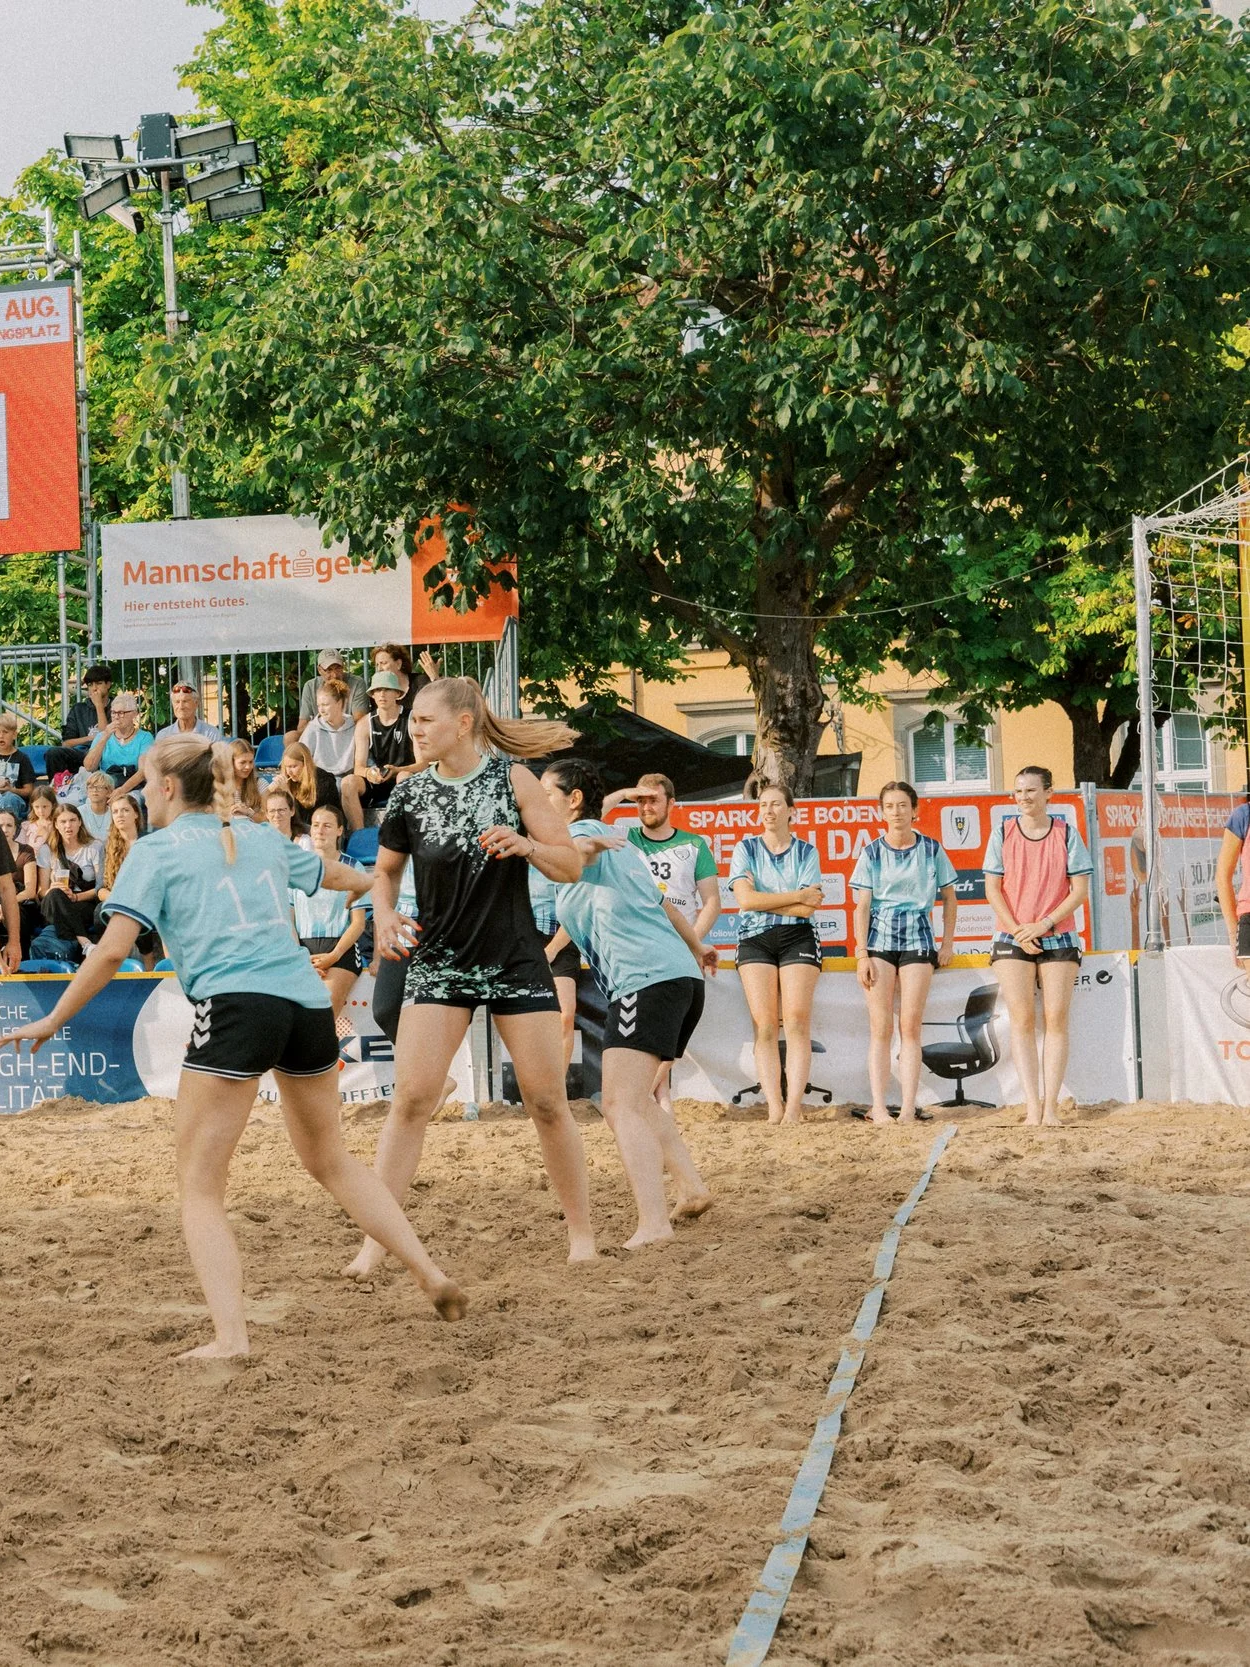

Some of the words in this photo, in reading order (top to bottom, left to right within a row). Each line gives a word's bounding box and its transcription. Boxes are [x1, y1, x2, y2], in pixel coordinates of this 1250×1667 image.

[6, 296, 59, 321] AUG.
[124, 600, 150, 611] Hier
[153, 597, 206, 610] entsteht
[209, 596, 249, 607] Gutes.
[815, 805, 882, 825] BODEN
[650, 861, 671, 880] 33
[216, 869, 287, 932] 11
[709, 928, 740, 938] follow
